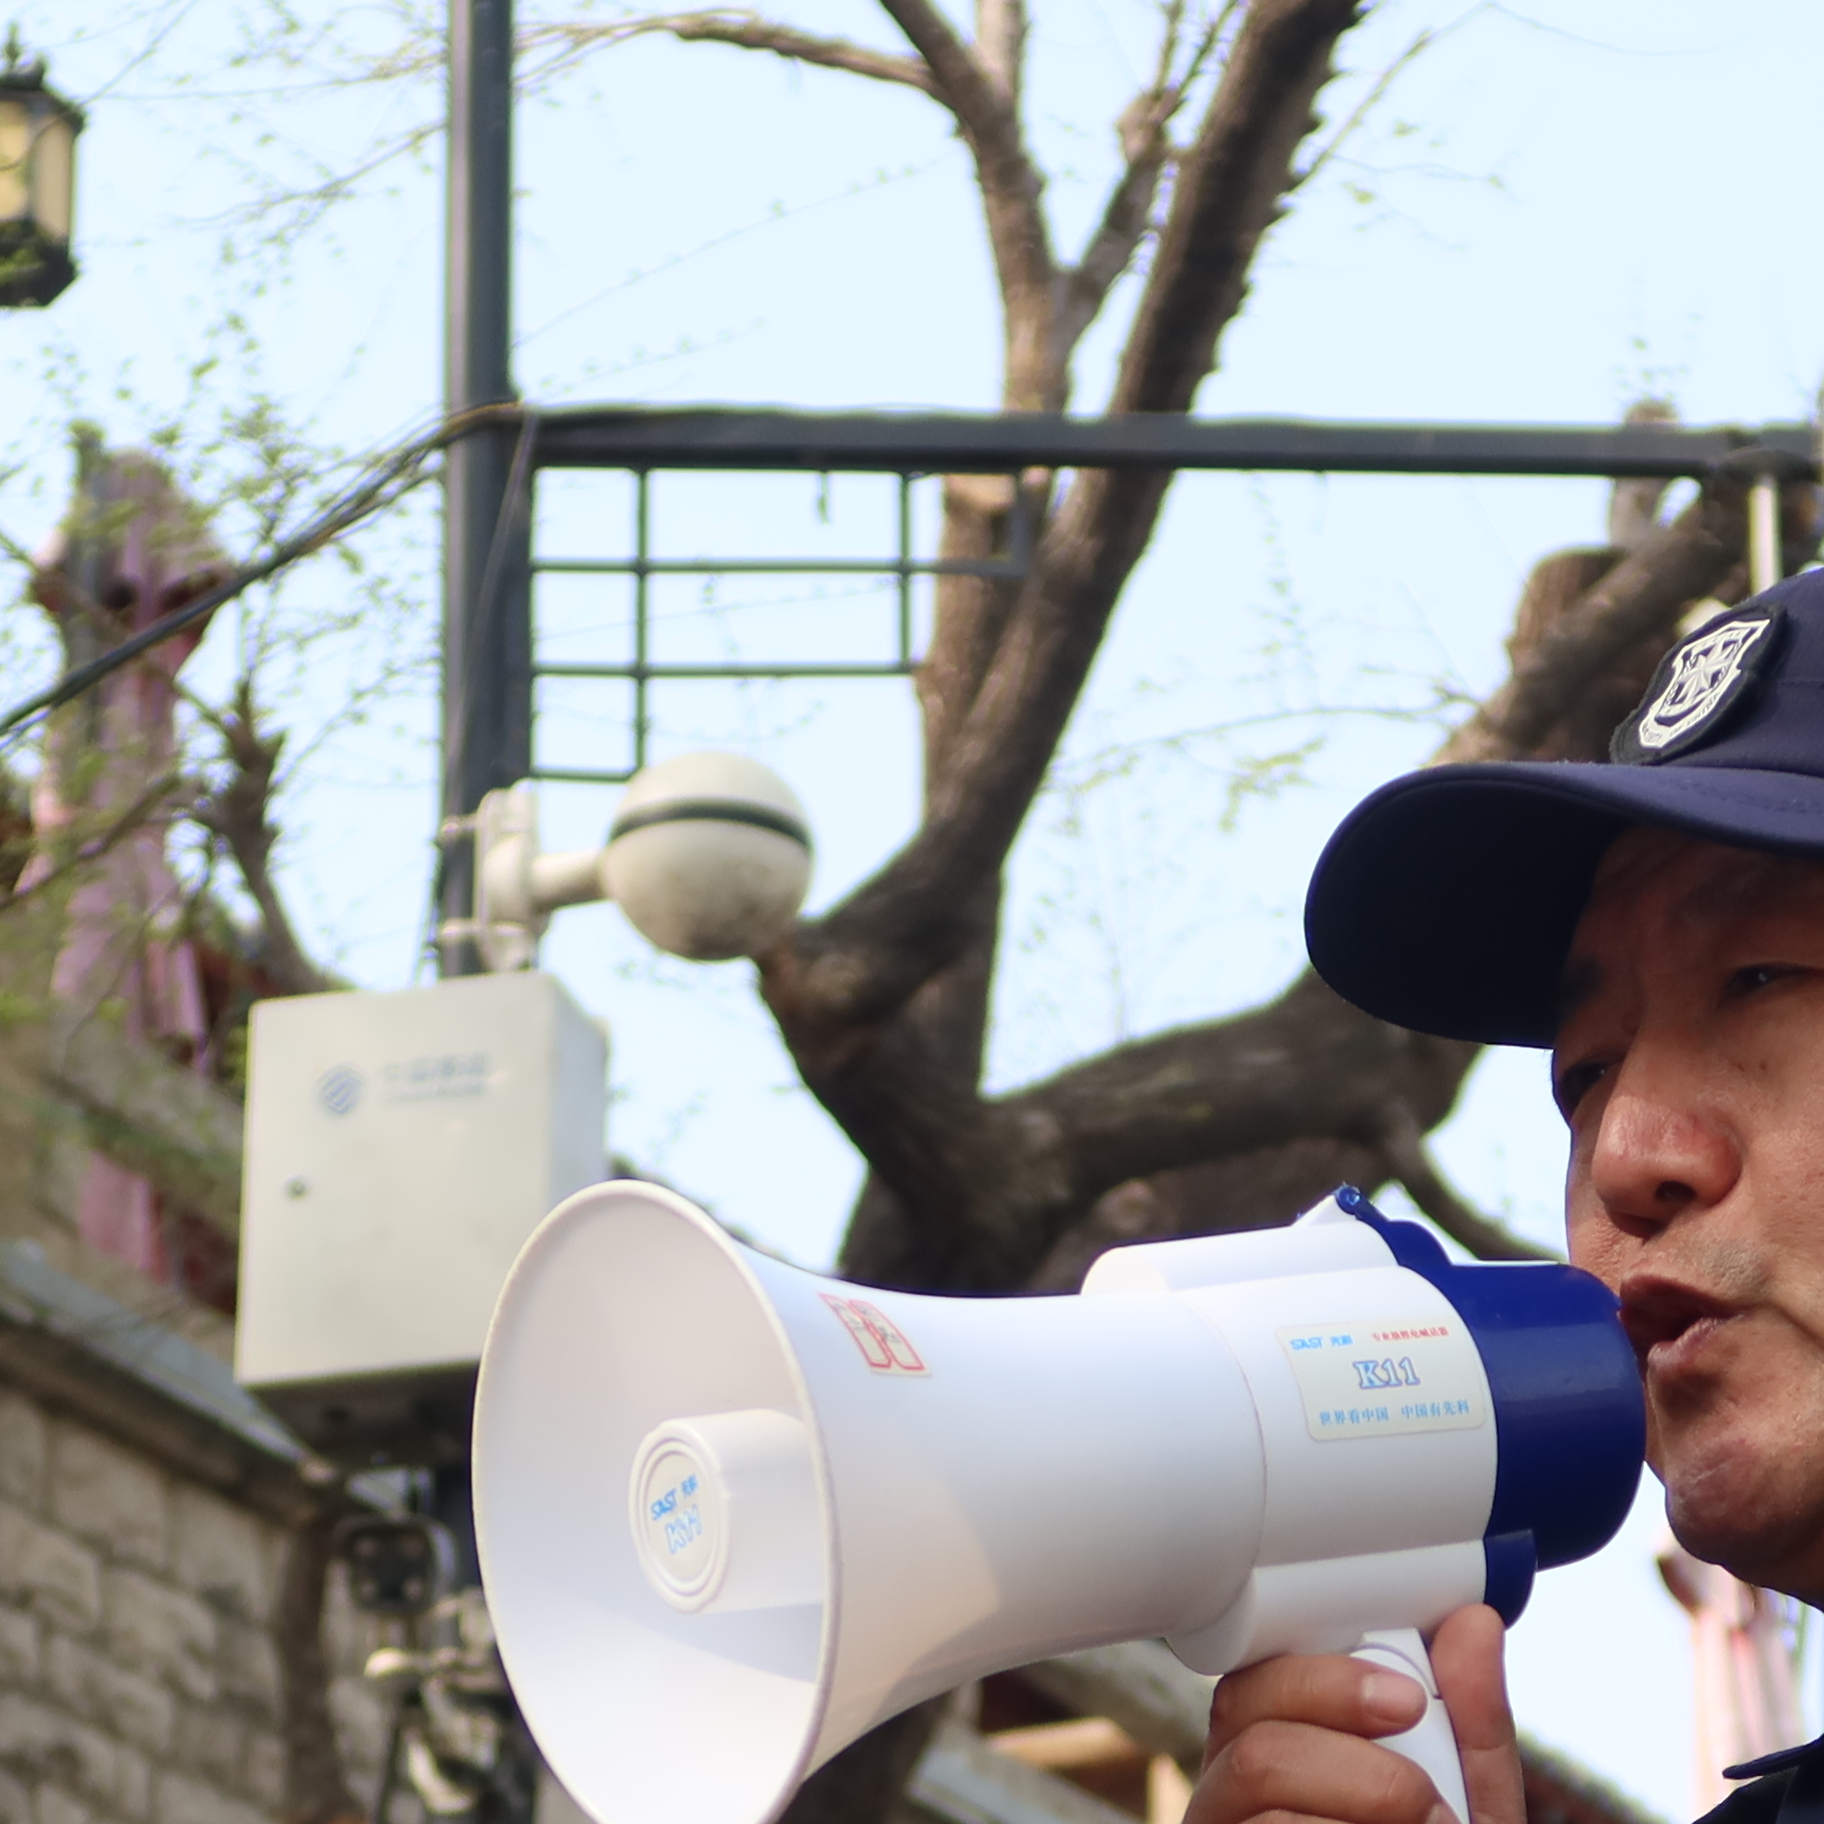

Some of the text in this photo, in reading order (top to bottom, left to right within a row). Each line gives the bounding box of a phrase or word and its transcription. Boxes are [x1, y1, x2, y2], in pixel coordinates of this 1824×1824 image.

[1290, 1336, 1324, 1351] SAST
[1352, 1356, 1421, 1390] K11
[1319, 1399, 1470, 1426] 世界看中国 中国有先科
